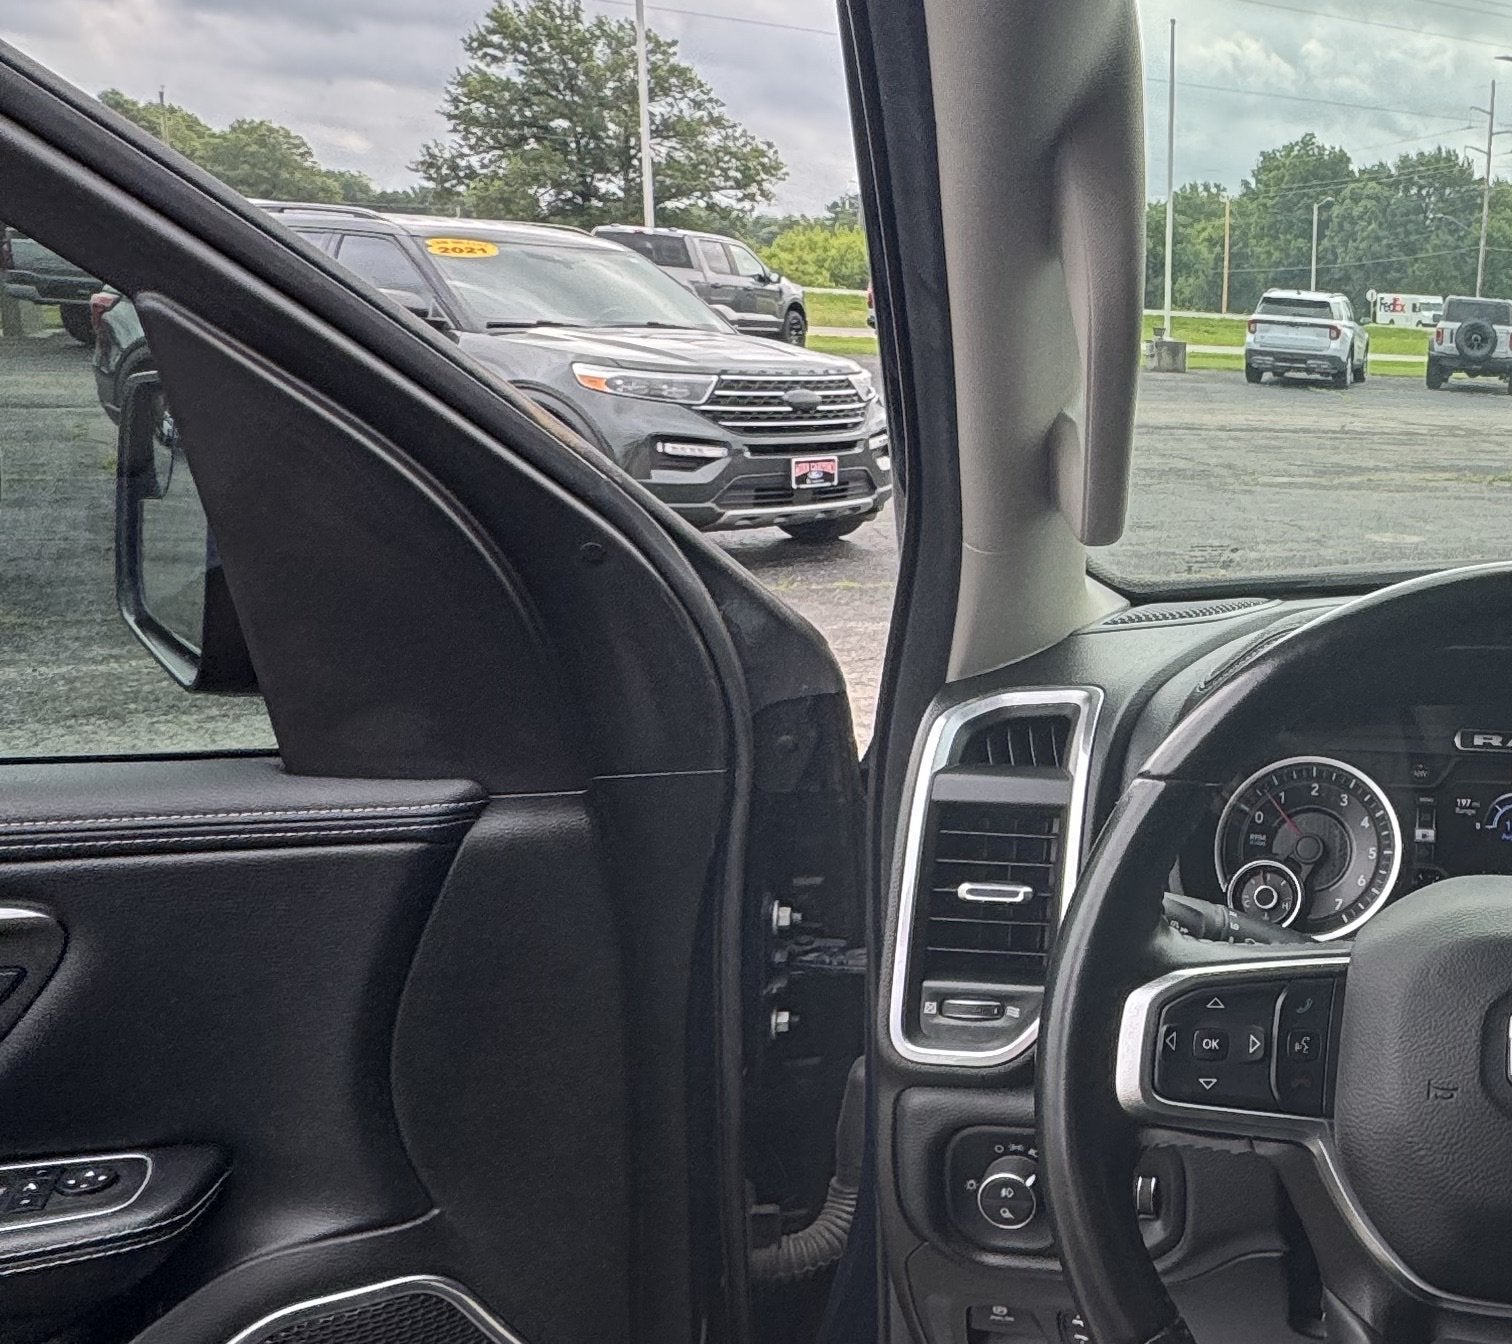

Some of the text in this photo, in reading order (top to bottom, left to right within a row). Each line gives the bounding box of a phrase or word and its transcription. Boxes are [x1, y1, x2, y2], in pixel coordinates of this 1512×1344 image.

[439, 246, 487, 254] 2021
[1379, 296, 1406, 313] FedEx
[1311, 783, 1319, 796] 2
[1279, 792, 1285, 804] 1
[1340, 794, 1348, 806] 3
[1456, 798, 1471, 807] 197
[1254, 811, 1263, 824] 0
[1360, 816, 1369, 828] 4
[1368, 848, 1377, 859] 5
[1357, 875, 1366, 886] 6
[1335, 898, 1343, 911] 7
[1202, 1038, 1220, 1050] OK
